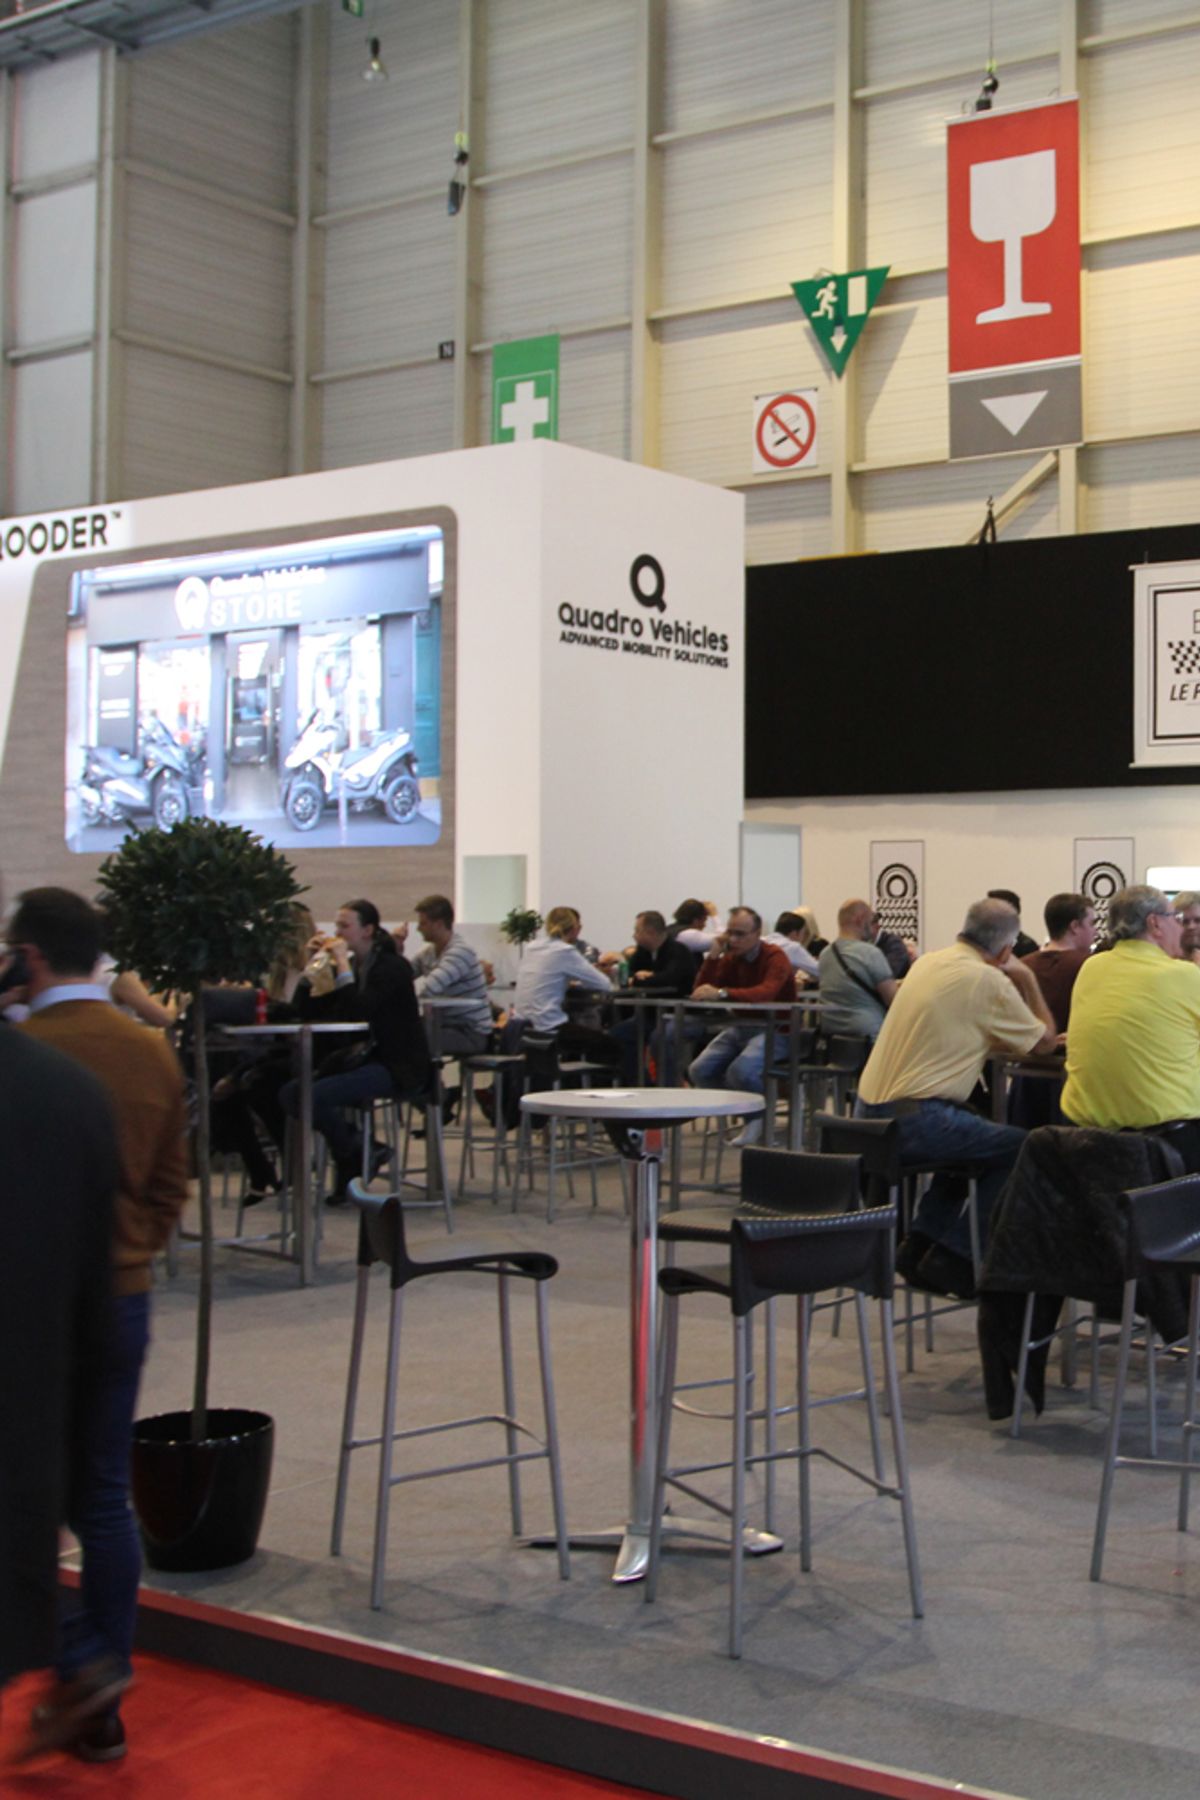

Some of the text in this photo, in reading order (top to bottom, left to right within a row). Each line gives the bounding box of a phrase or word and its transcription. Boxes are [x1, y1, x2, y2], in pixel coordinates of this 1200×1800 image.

[0, 513, 108, 560] OODER
[558, 602, 729, 653] Quadro Vehicles
[559, 630, 729, 669] ADVANCED MOBILITY SOLUTIONS
[1169, 683, 1190, 701] LE
